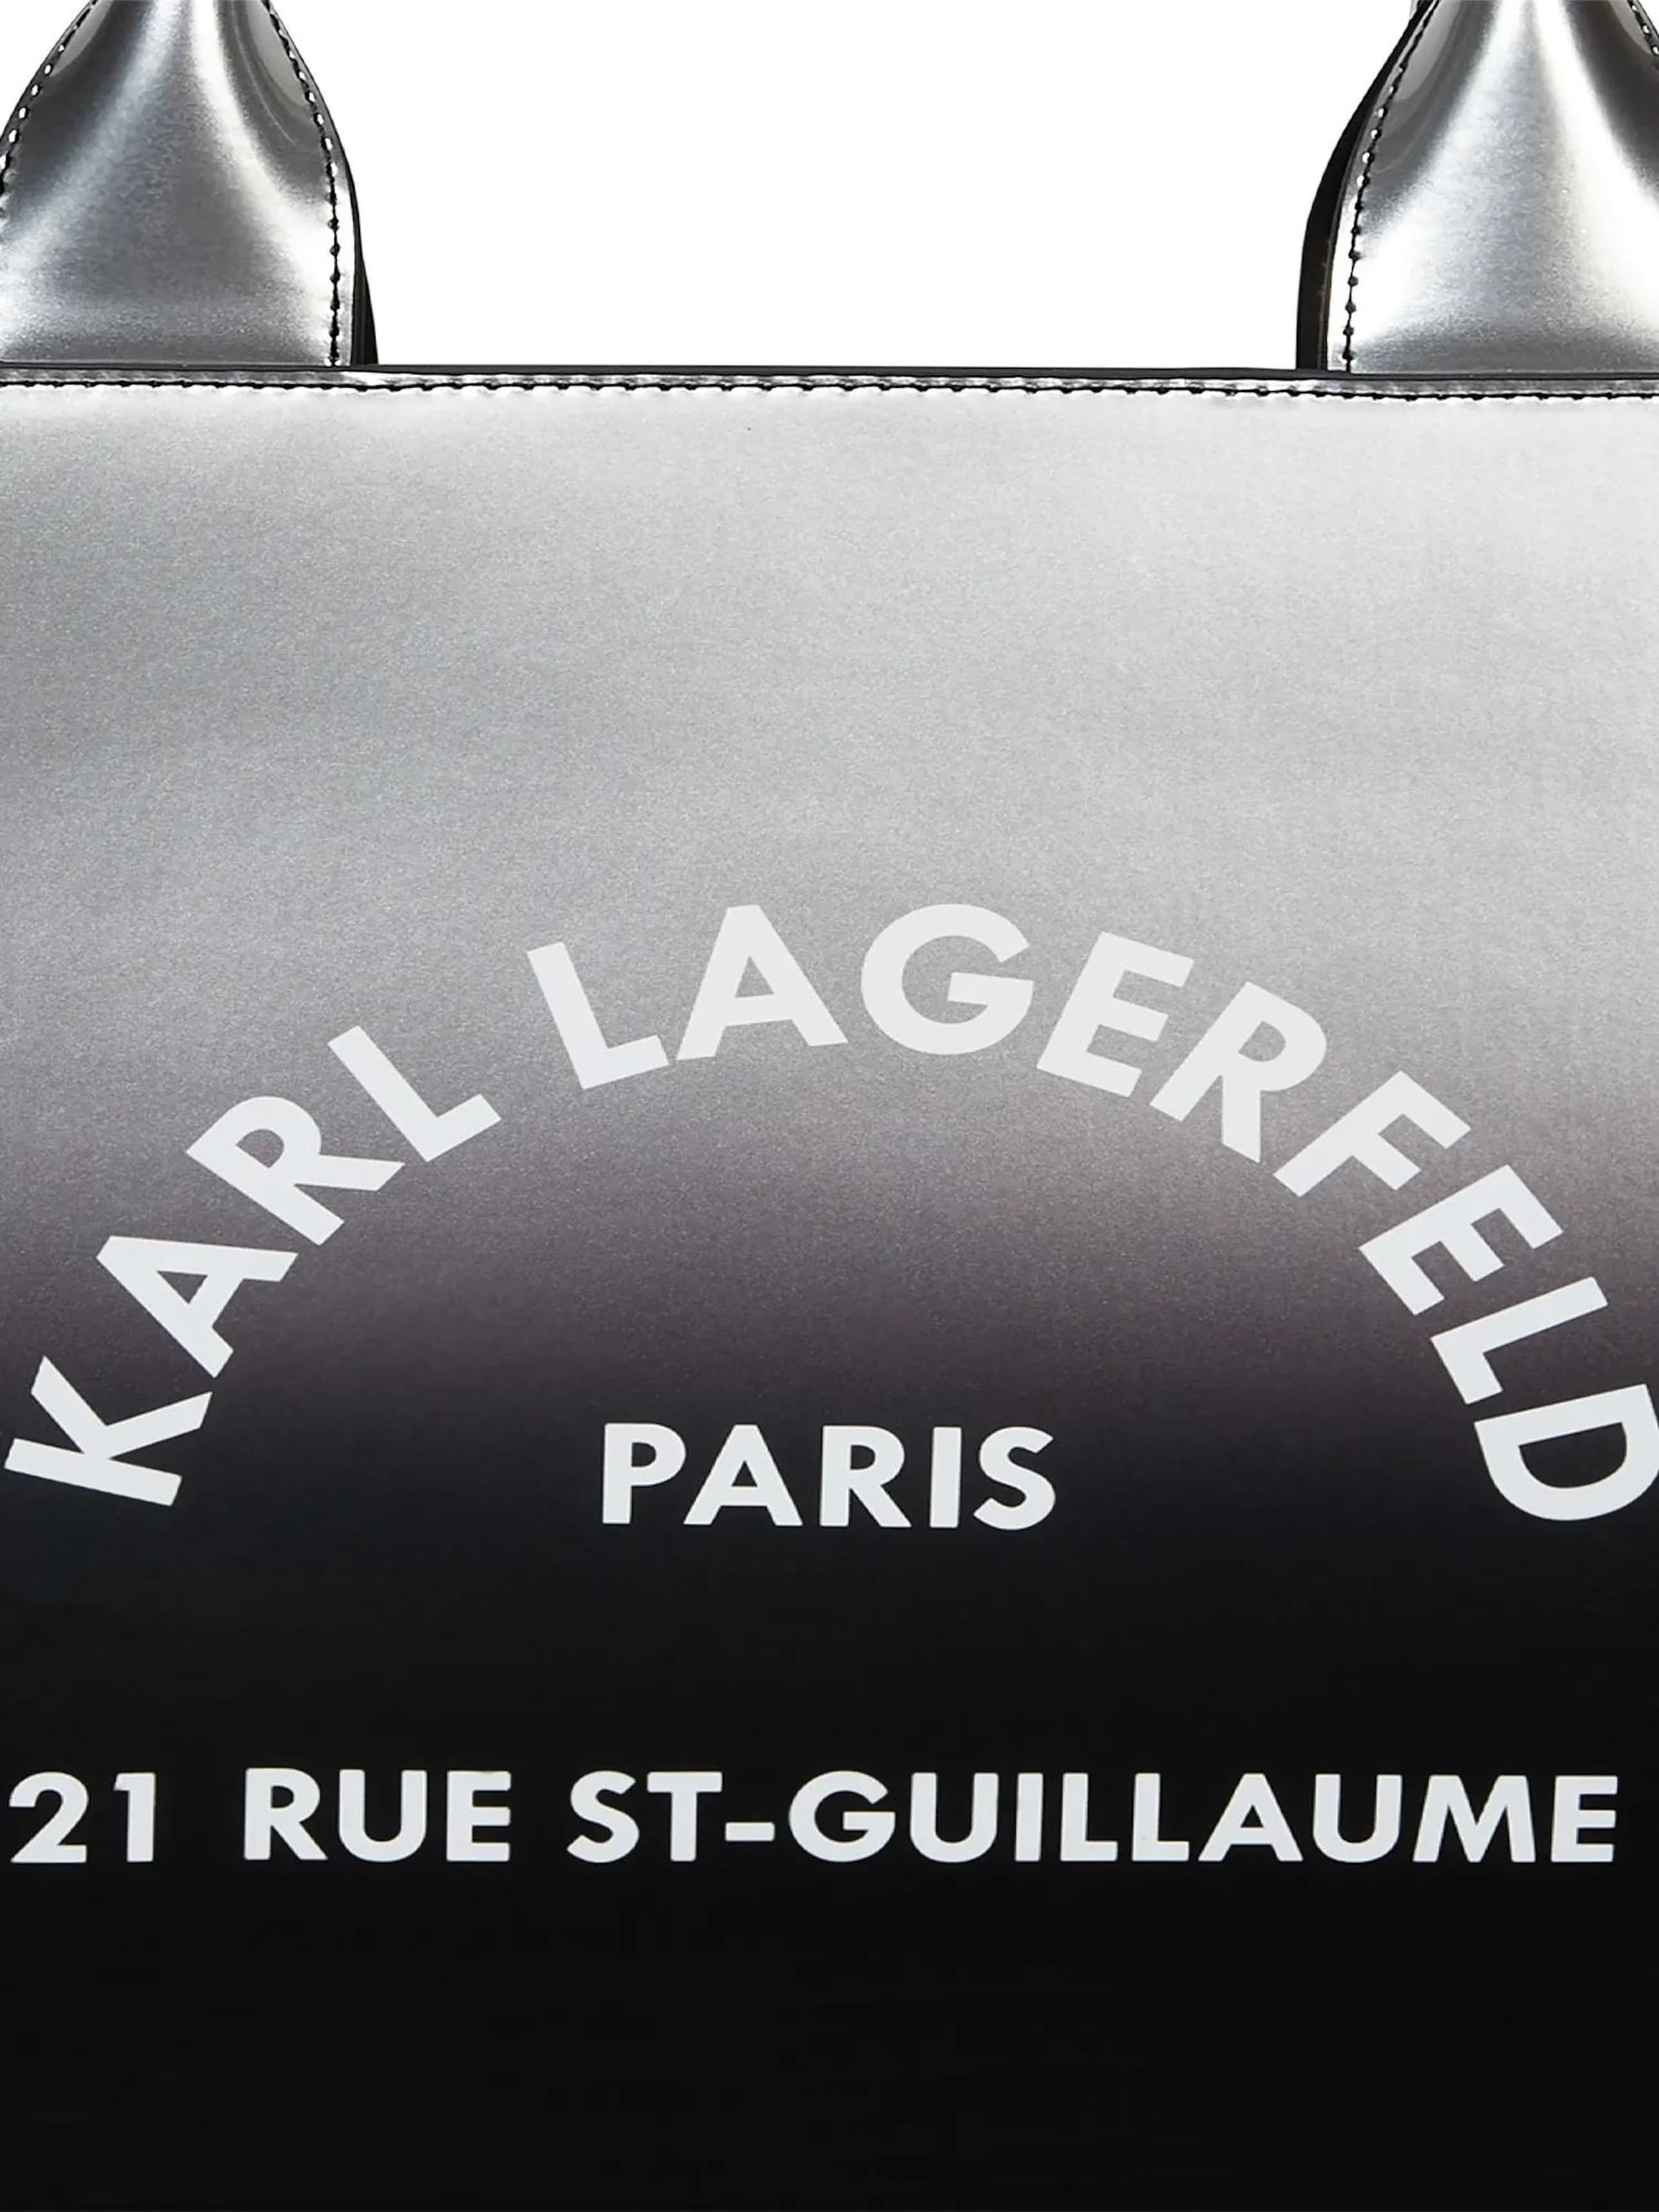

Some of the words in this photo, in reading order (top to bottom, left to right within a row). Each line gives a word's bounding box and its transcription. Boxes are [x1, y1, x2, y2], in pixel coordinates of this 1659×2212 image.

[5, 1025, 502, 1507] KARL
[526, 902, 1659, 1521] LAGERFELD
[602, 1424, 1056, 1531] PARIS
[9, 1771, 158, 1864] 21
[243, 1768, 512, 1863] RUE
[566, 1770, 1618, 1864] ST-GUILLAUME
